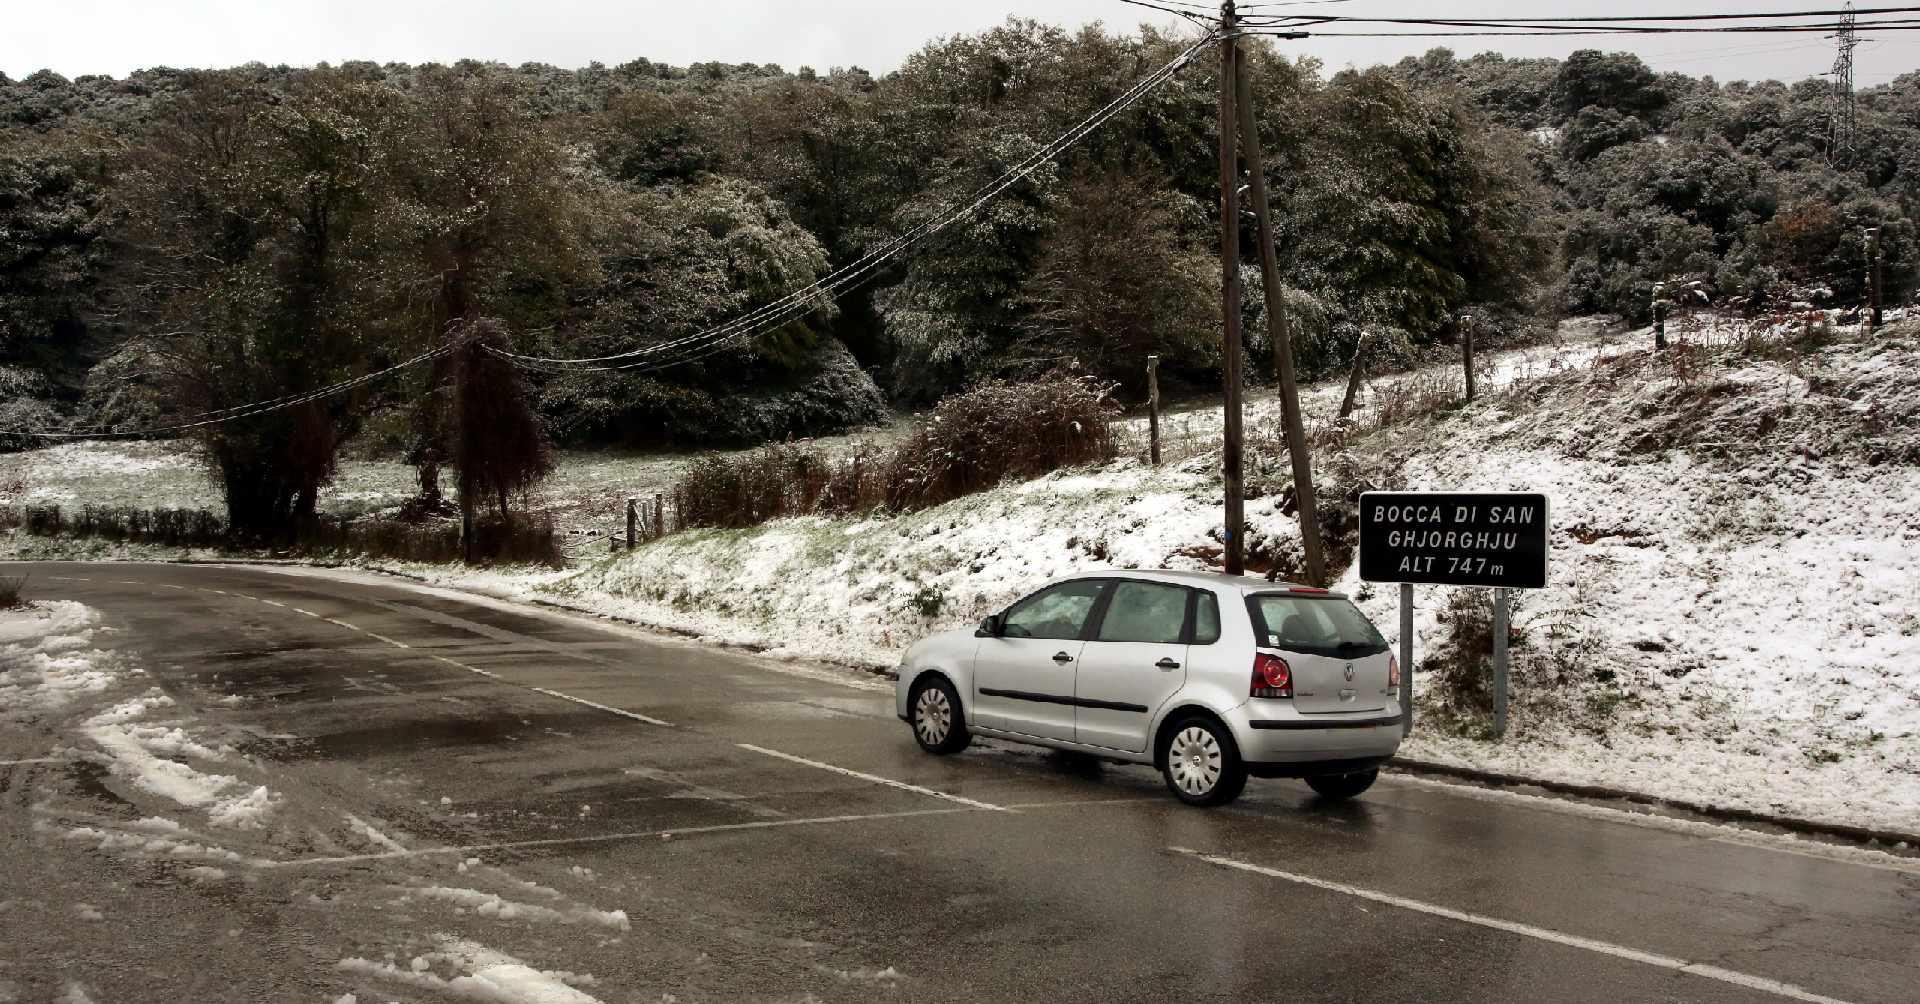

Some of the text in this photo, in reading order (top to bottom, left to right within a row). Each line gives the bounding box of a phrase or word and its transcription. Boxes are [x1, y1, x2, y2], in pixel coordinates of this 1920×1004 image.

[1373, 505, 1534, 524] BOCCA DI SAN
[1388, 530, 1517, 550] GHJORGHJU
[1398, 555, 1436, 573] ALT
